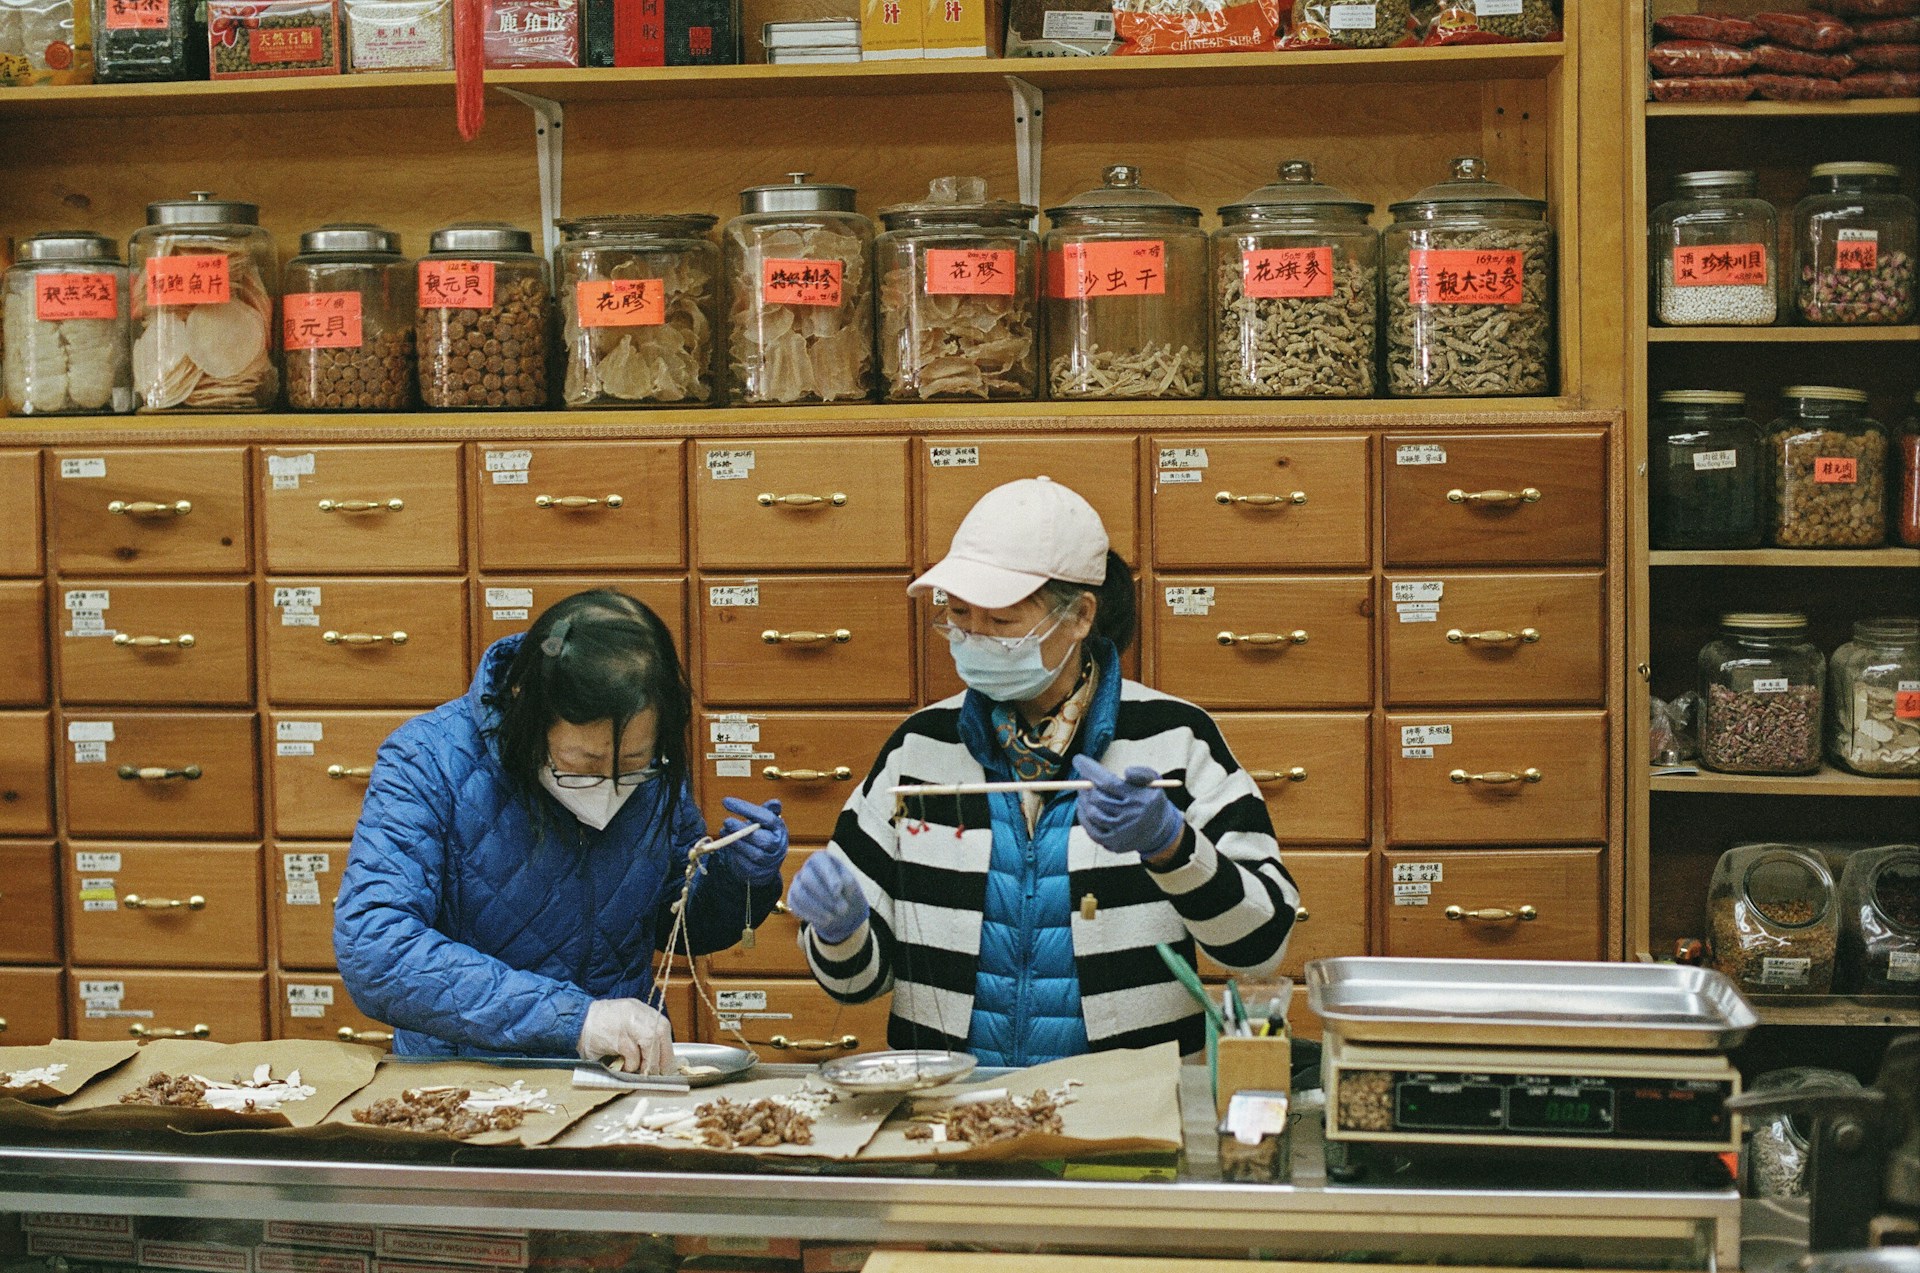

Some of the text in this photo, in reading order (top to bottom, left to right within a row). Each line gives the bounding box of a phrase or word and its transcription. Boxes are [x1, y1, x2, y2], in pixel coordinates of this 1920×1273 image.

[884, 3, 900, 24] 汁
[946, 1, 962, 21] 汁
[259, 31, 313, 47] 天然石斛
[1171, 37, 1224, 51] CHINESE
[949, 260, 1004, 285] 花膠
